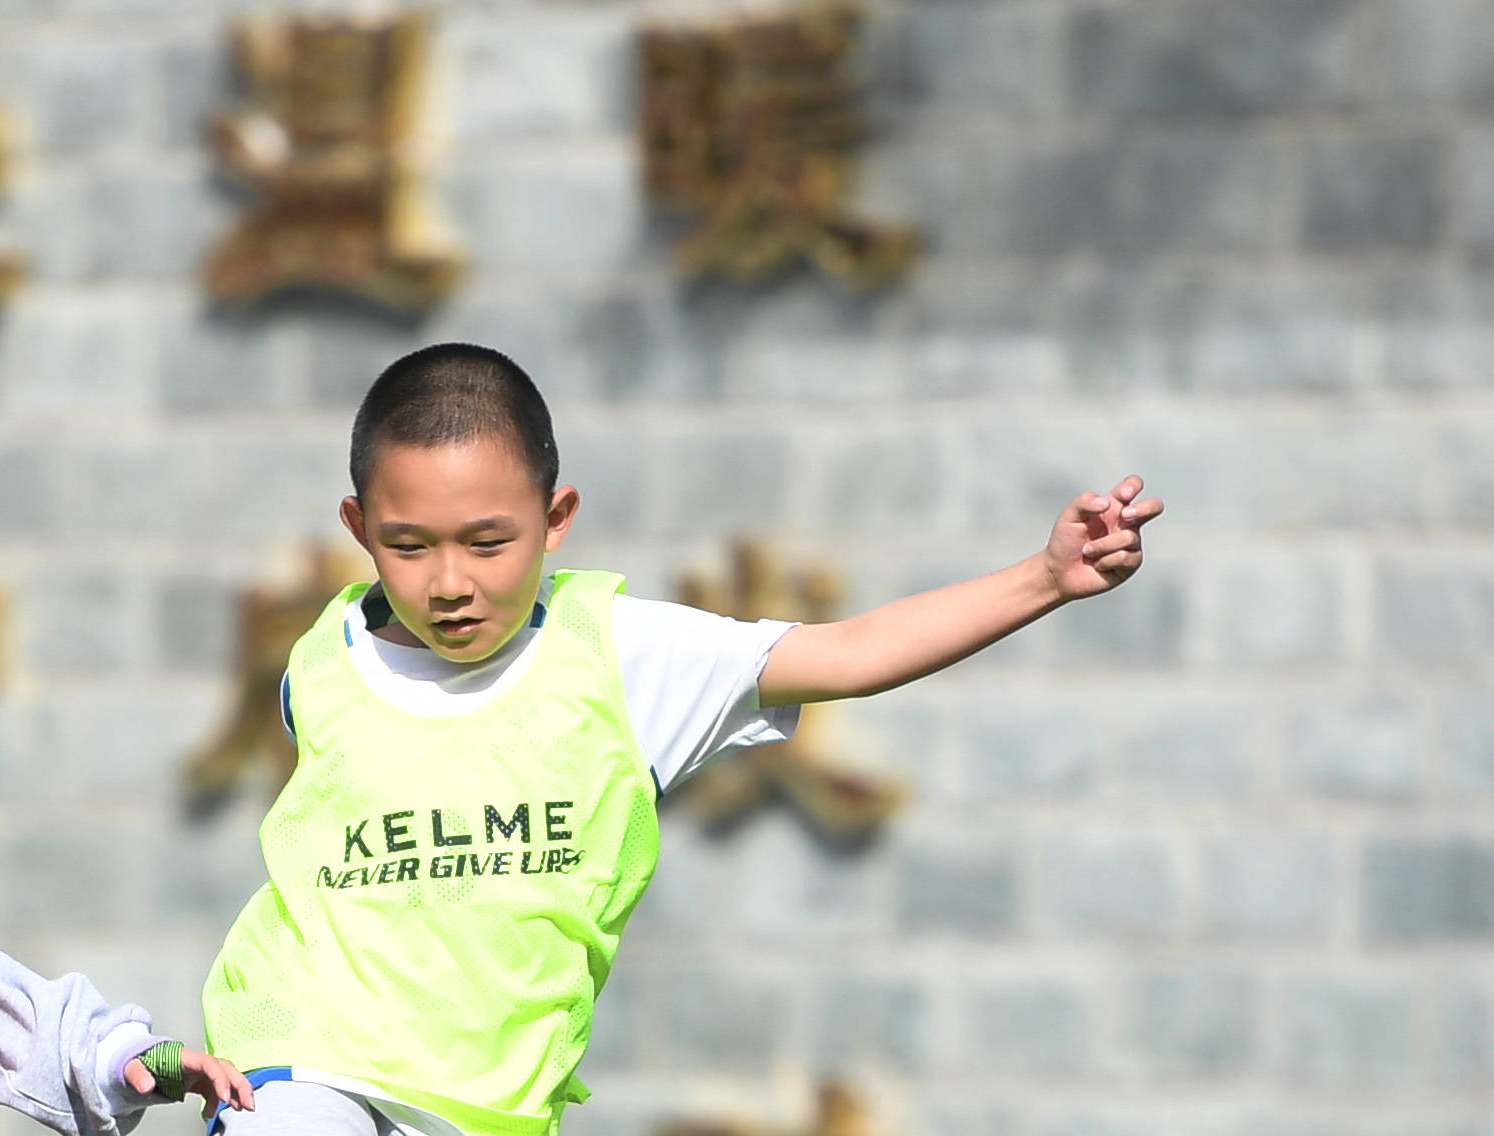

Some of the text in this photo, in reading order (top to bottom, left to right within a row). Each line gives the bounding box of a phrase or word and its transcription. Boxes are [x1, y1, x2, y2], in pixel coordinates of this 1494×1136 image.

[344, 801, 574, 863] KELME
[316, 857, 420, 889] NEVER
[429, 852, 514, 878] GIVE
